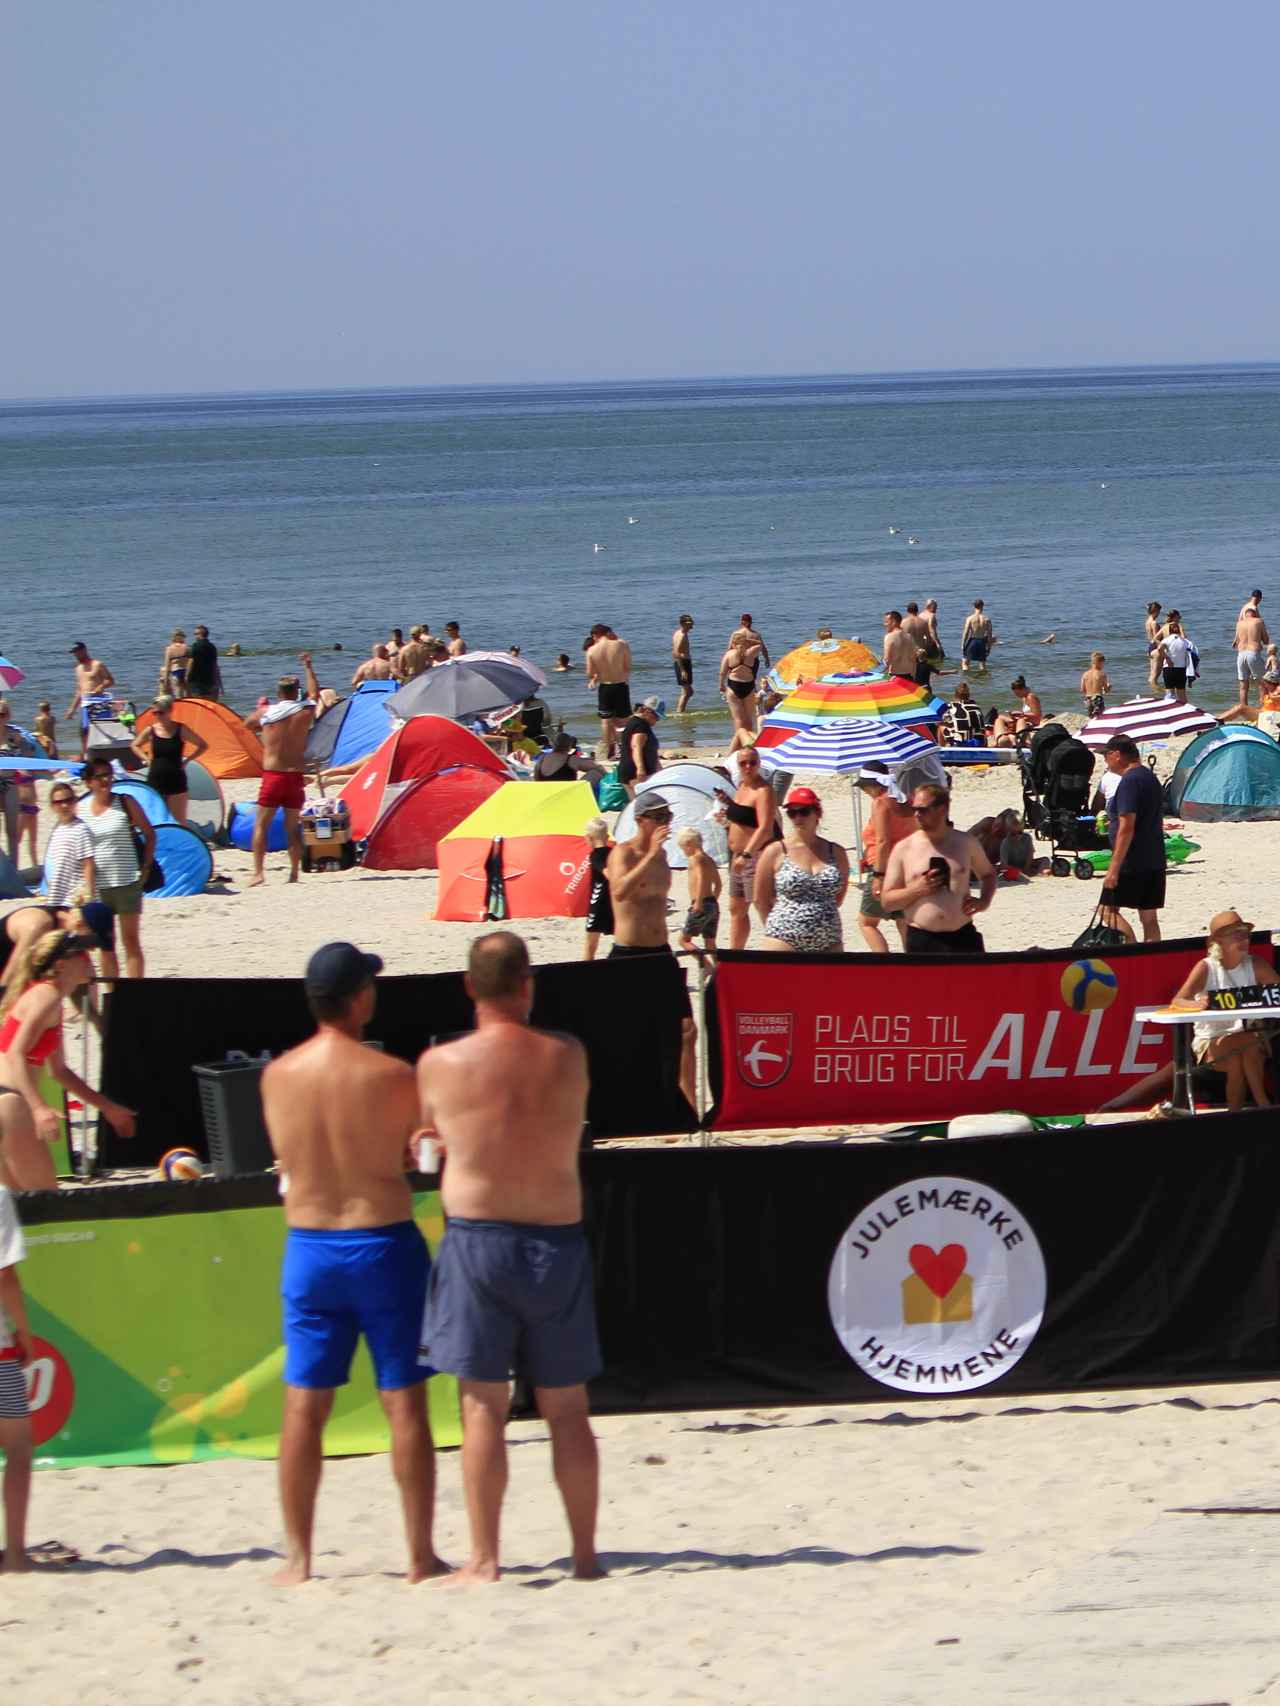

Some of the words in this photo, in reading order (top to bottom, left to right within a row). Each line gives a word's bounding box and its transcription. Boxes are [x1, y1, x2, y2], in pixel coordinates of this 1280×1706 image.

[1215, 992, 1237, 1009] 10
[815, 1015, 912, 1043] PLADS
[926, 1015, 968, 1043] TIL
[967, 1004, 1170, 1080] ALLE
[814, 1054, 895, 1083] BRUG
[907, 1053, 964, 1082] FOR
[851, 1188, 1025, 1260] JULEMÆRKE
[859, 1327, 1020, 1385] HJEMMENE
